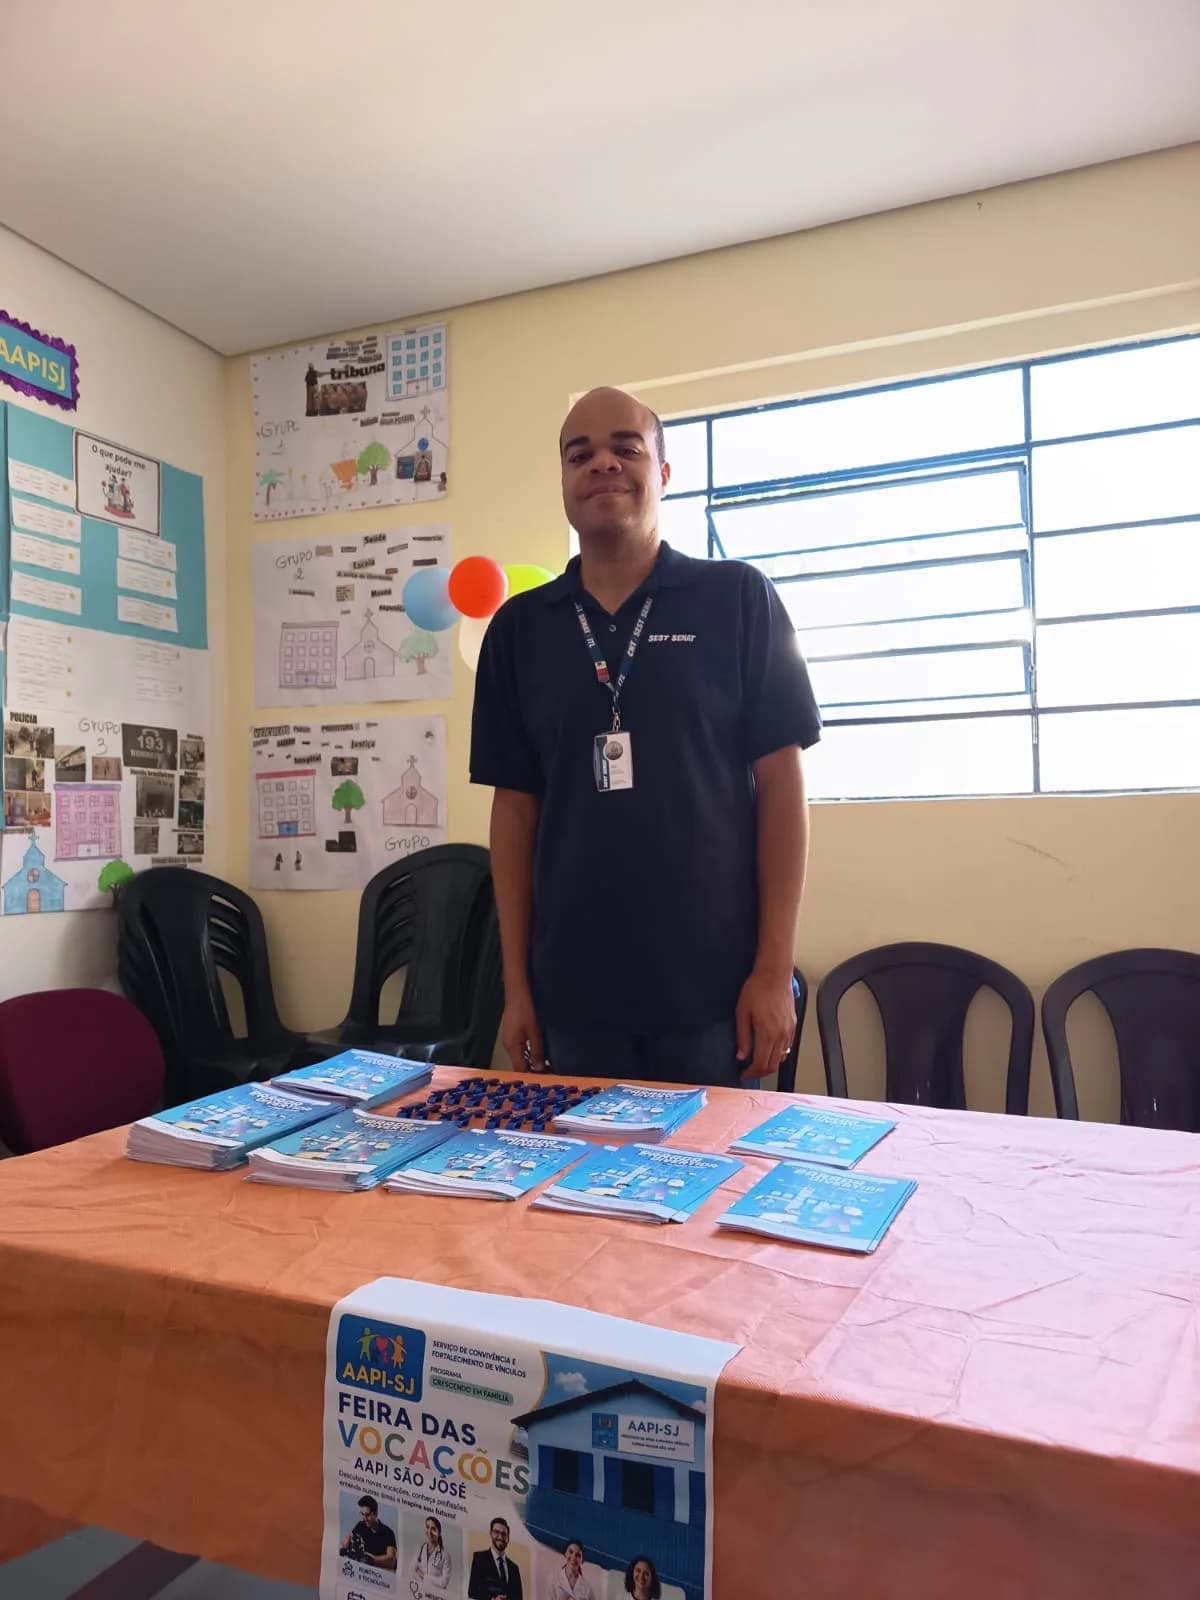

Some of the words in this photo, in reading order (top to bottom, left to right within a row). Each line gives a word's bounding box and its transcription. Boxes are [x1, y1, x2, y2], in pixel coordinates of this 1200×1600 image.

[330, 362, 385, 380] tribuna
[92, 444, 98, 453] O
[100, 449, 113, 460] que
[115, 454, 132, 466] pode
[133, 461, 146, 470] me
[105, 463, 132, 479] ajudar?
[627, 640, 637, 657] CNT
[648, 634, 670, 642] SEST
[671, 634, 697, 643] SENAT
[95, 737, 108, 755] 3
[137, 735, 164, 751] 193
[433, 1340, 458, 1352] SERVIÇO
[460, 1346, 467, 1354] DE
[468, 1348, 511, 1364] CONVIVÊNCIA
[511, 1358, 516, 1366] E
[430, 1366, 462, 1379] PROGRAMA
[432, 1351, 484, 1368] FORTALECIMENTO
[485, 1362, 493, 1370] DE
[495, 1363, 527, 1378] VÍNCULOS
[342, 1361, 415, 1395] AAPI-SJ
[433, 1378, 471, 1393] CRESCENDO
[472, 1387, 482, 1396] EM
[484, 1390, 510, 1402] FAMÍLIA
[338, 1391, 412, 1431] FEIRA
[421, 1412, 477, 1446] DAS
[628, 1420, 680, 1437] AAPI-SJ
[354, 1457, 388, 1478] AAPI
[393, 1466, 424, 1487] SÃO
[429, 1477, 467, 1500] JOSÉ
[339, 1469, 365, 1484] Descubra
[365, 1479, 382, 1488] novas
[382, 1484, 411, 1497] vocações,
[411, 1492, 436, 1504] conheça
[437, 1500, 469, 1513] profissões,
